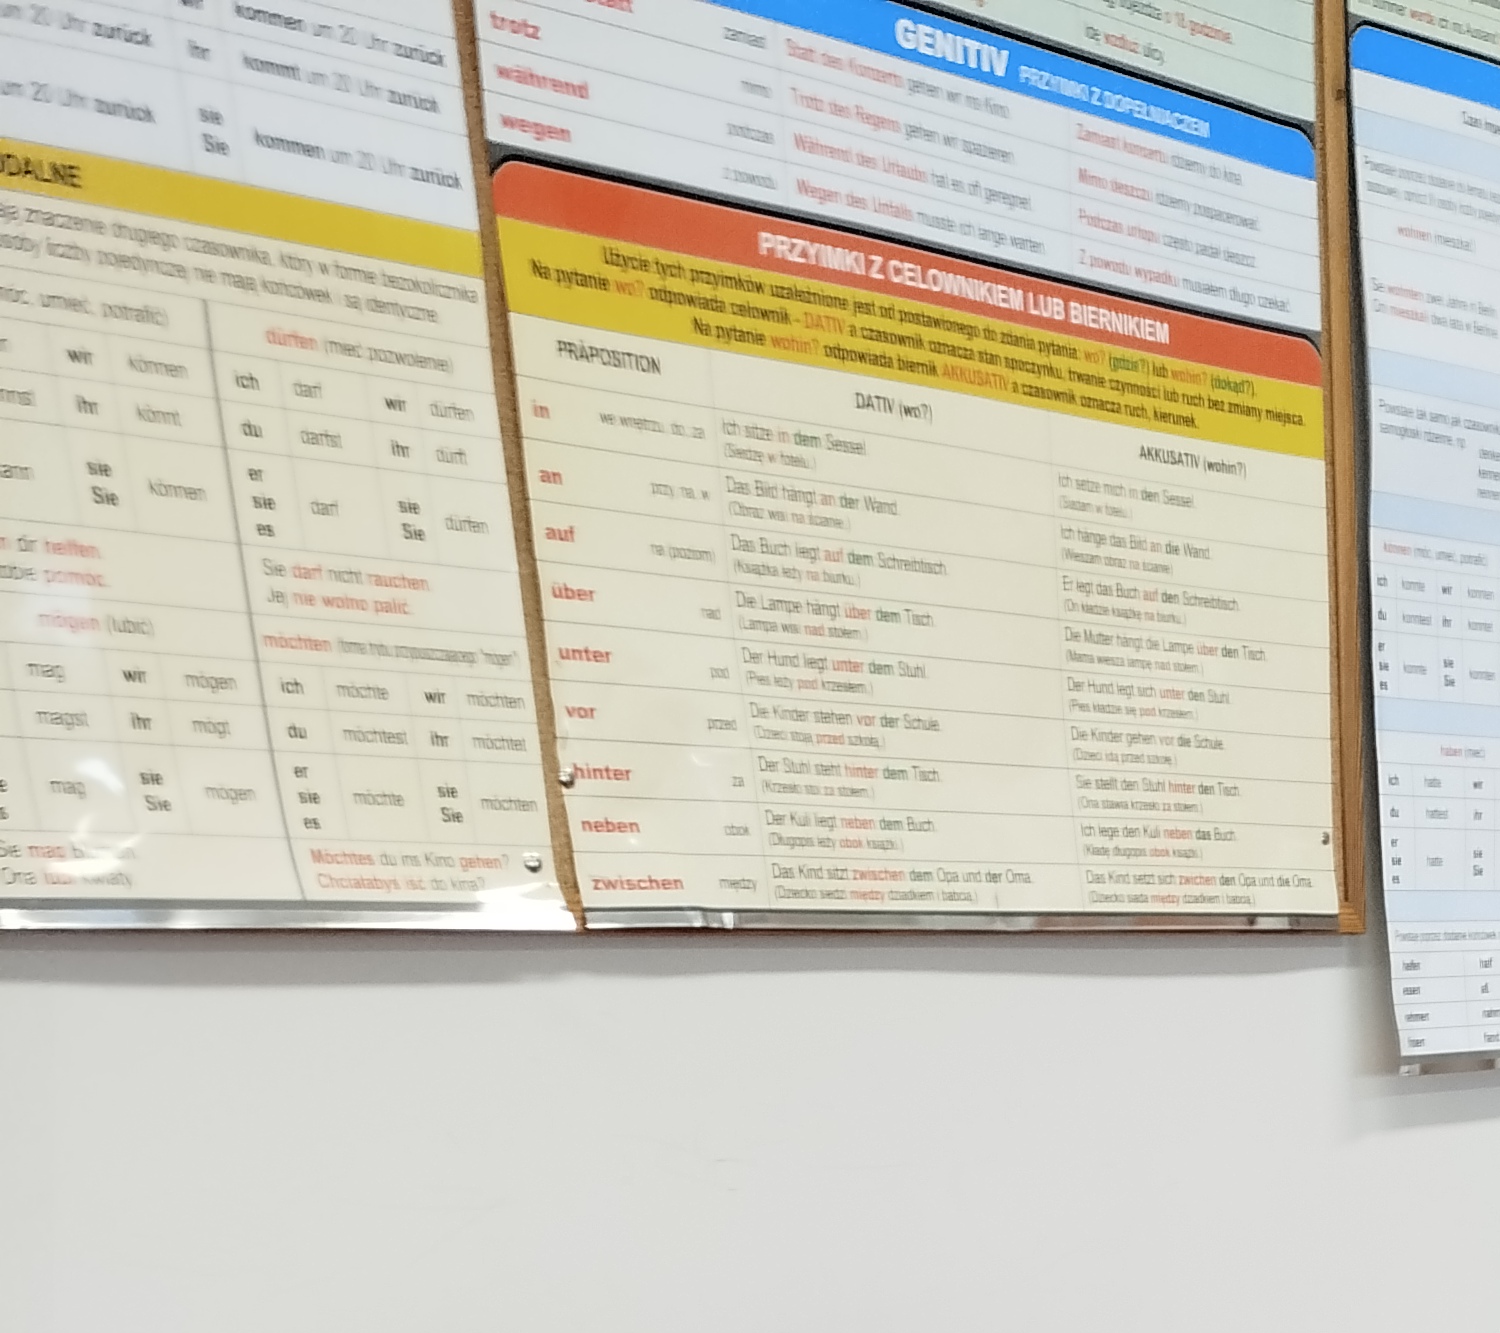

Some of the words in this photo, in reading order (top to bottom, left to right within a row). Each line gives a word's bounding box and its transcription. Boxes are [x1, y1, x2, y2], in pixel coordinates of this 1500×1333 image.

[490, 11, 541, 41] trotz
[894, 18, 1009, 78] GENITIV
[502, 112, 572, 143] wegen
[0, 152, 82, 189] DALNE
[531, 259, 551, 279] Na
[556, 267, 609, 291] pytanie
[758, 231, 865, 276] PRZYIMKI
[868, 256, 885, 281] Z
[887, 260, 1024, 312] CELOWNIKIEM
[1026, 291, 1065, 321] LUB
[1068, 301, 1169, 344] BIERNIKIEM
[691, 316, 711, 336] Na
[556, 340, 662, 375] PRÄPOSITION
[532, 399, 550, 419] in
[855, 392, 894, 415] DATIV
[1138, 444, 1201, 469] AKKUSATIV
[538, 468, 563, 486] an
[544, 524, 577, 542] auf
[551, 581, 595, 602] über
[558, 644, 612, 664] unter
[424, 688, 446, 704] wir
[565, 704, 597, 721] vor
[429, 731, 449, 747] ihr
[573, 763, 632, 782] hinter
[436, 784, 458, 800] sie
[440, 806, 464, 824] Sie
[581, 817, 640, 834] neben
[592, 873, 684, 892] zwischen
